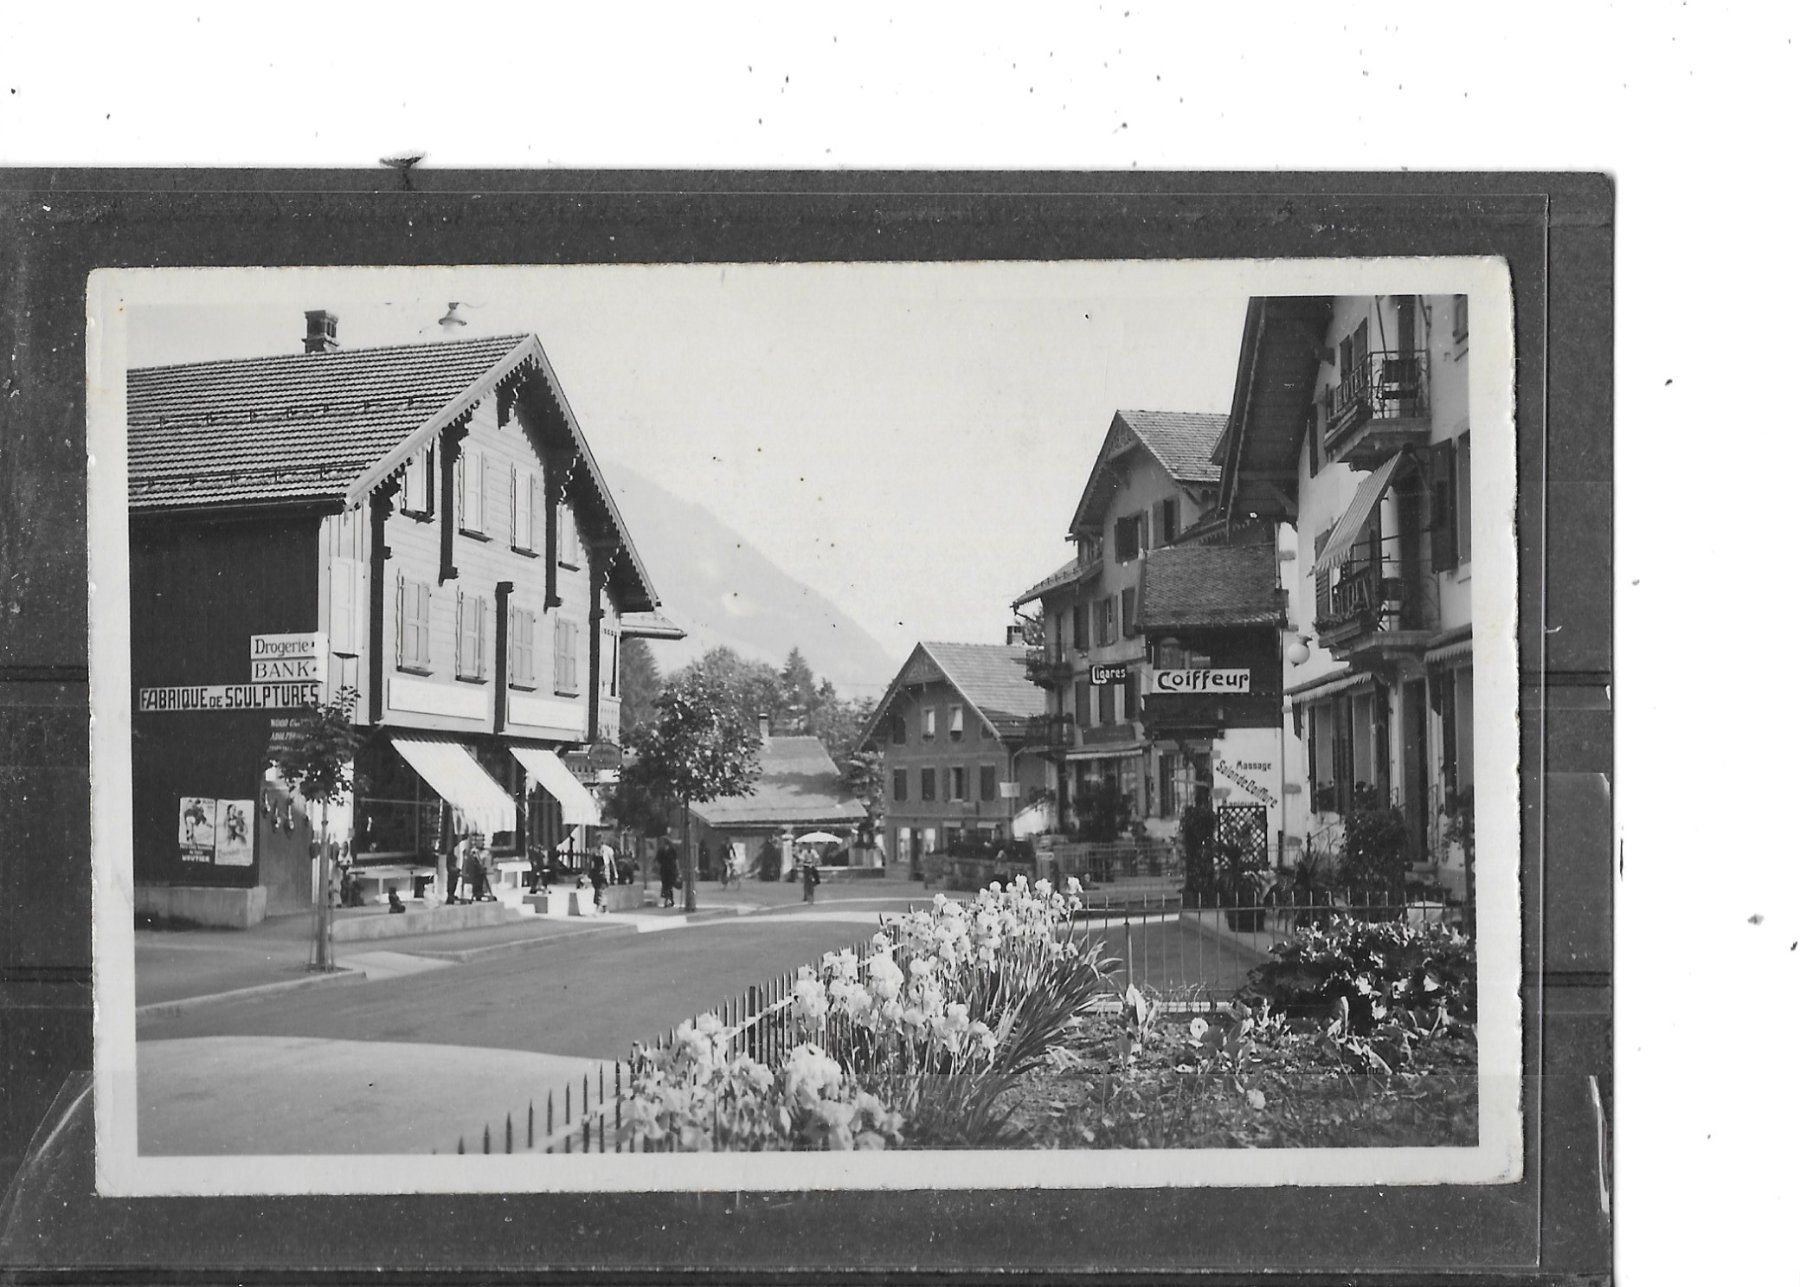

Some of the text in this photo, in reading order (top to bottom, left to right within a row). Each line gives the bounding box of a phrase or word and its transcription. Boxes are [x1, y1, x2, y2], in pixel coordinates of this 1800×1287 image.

[254, 638, 309, 657] Drogerie
[254, 660, 309, 679] BANK
[1091, 664, 1126, 685] Cigares
[1157, 670, 1249, 692] Coiffeur
[141, 684, 319, 710] FABRIQUE DE SCULPTURES
[1236, 760, 1272, 773] Massage
[1216, 759, 1278, 809] Salon de Coiffure
